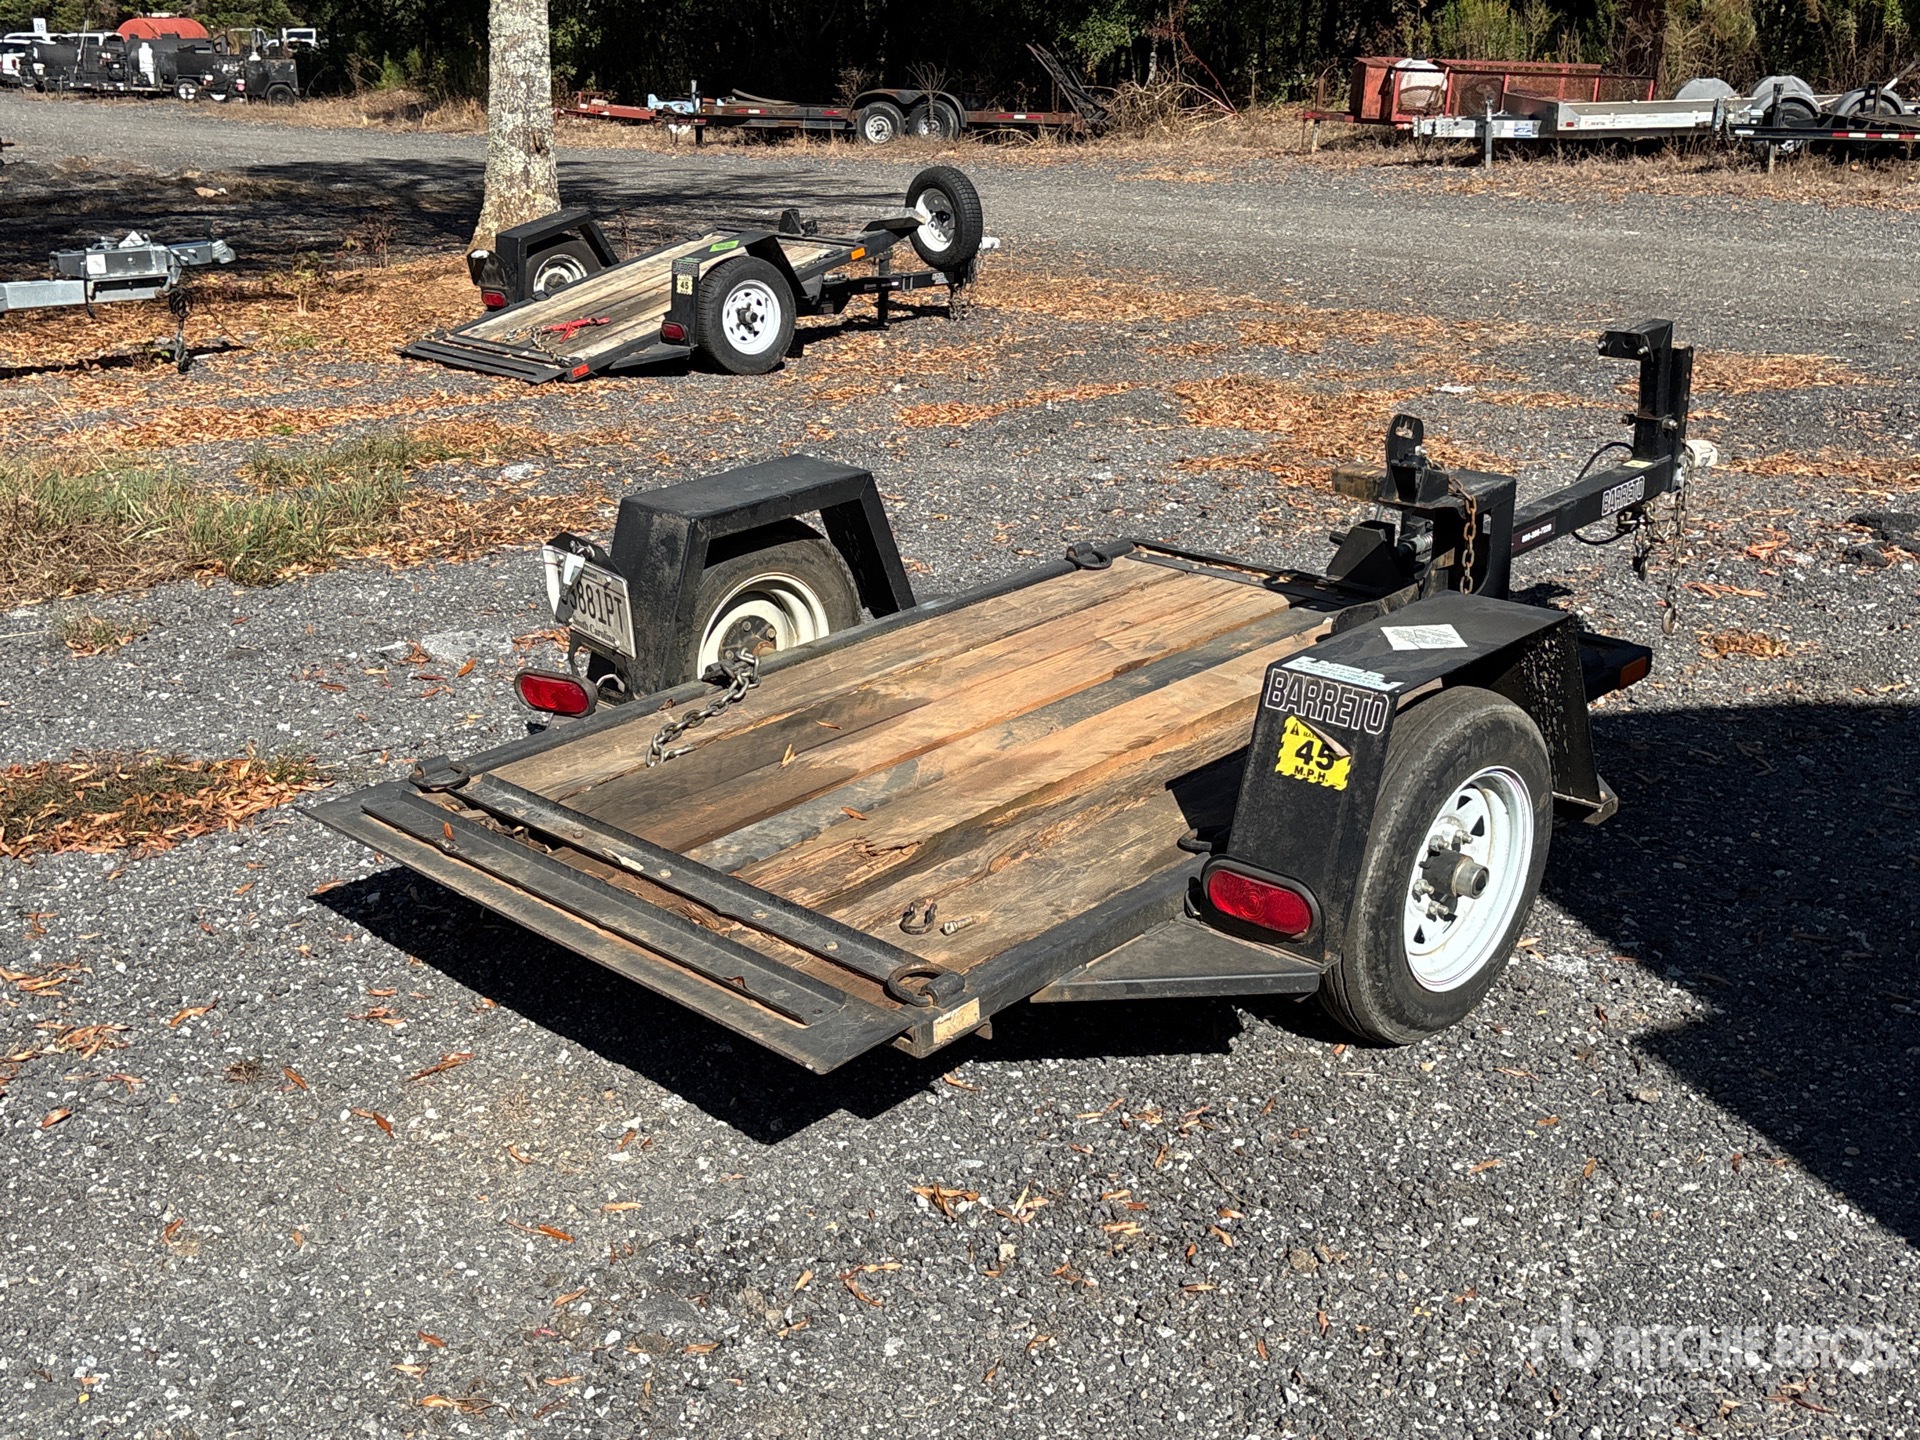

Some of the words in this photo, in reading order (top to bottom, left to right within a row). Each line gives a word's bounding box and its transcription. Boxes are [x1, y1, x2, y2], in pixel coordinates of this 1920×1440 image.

[680, 280, 690, 290] 45
[1601, 475, 1646, 516] BARRETO
[589, 624, 616, 643] Carolina
[1265, 668, 1389, 735] BARRETO
[1295, 740, 1334, 771] 45
[1294, 765, 1328, 783] M.P.H.
